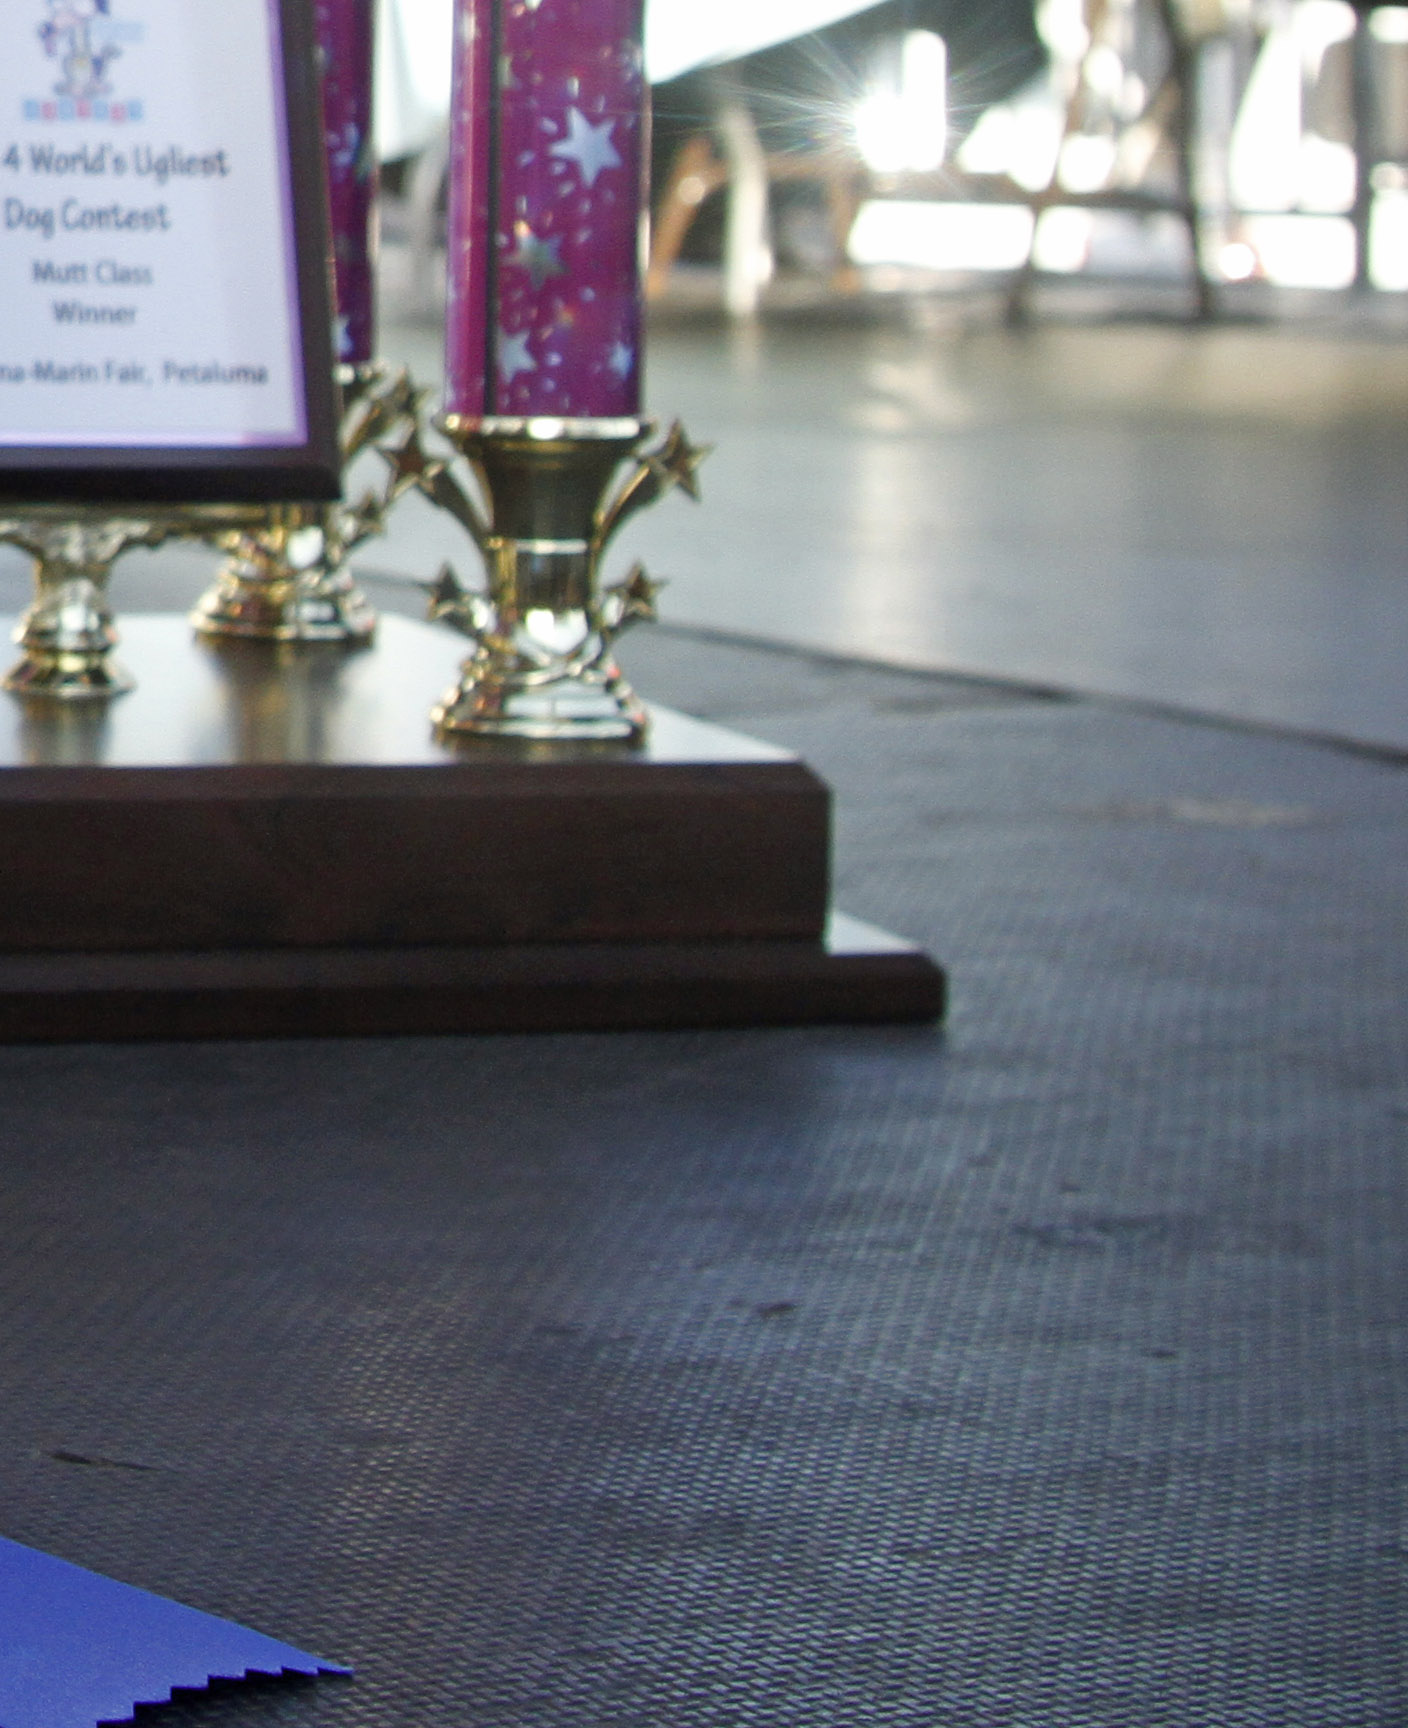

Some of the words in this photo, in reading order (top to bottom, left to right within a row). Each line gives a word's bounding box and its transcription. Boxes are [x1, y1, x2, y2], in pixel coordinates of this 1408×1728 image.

[30, 141, 128, 173] World's
[135, 142, 229, 185] Ugliest
[4, 197, 55, 238] Dog
[61, 197, 171, 232] Contest
[32, 259, 88, 285] Mutt
[95, 259, 154, 285] Class
[52, 299, 137, 323] Winner
[163, 359, 269, 386] Petaluma
